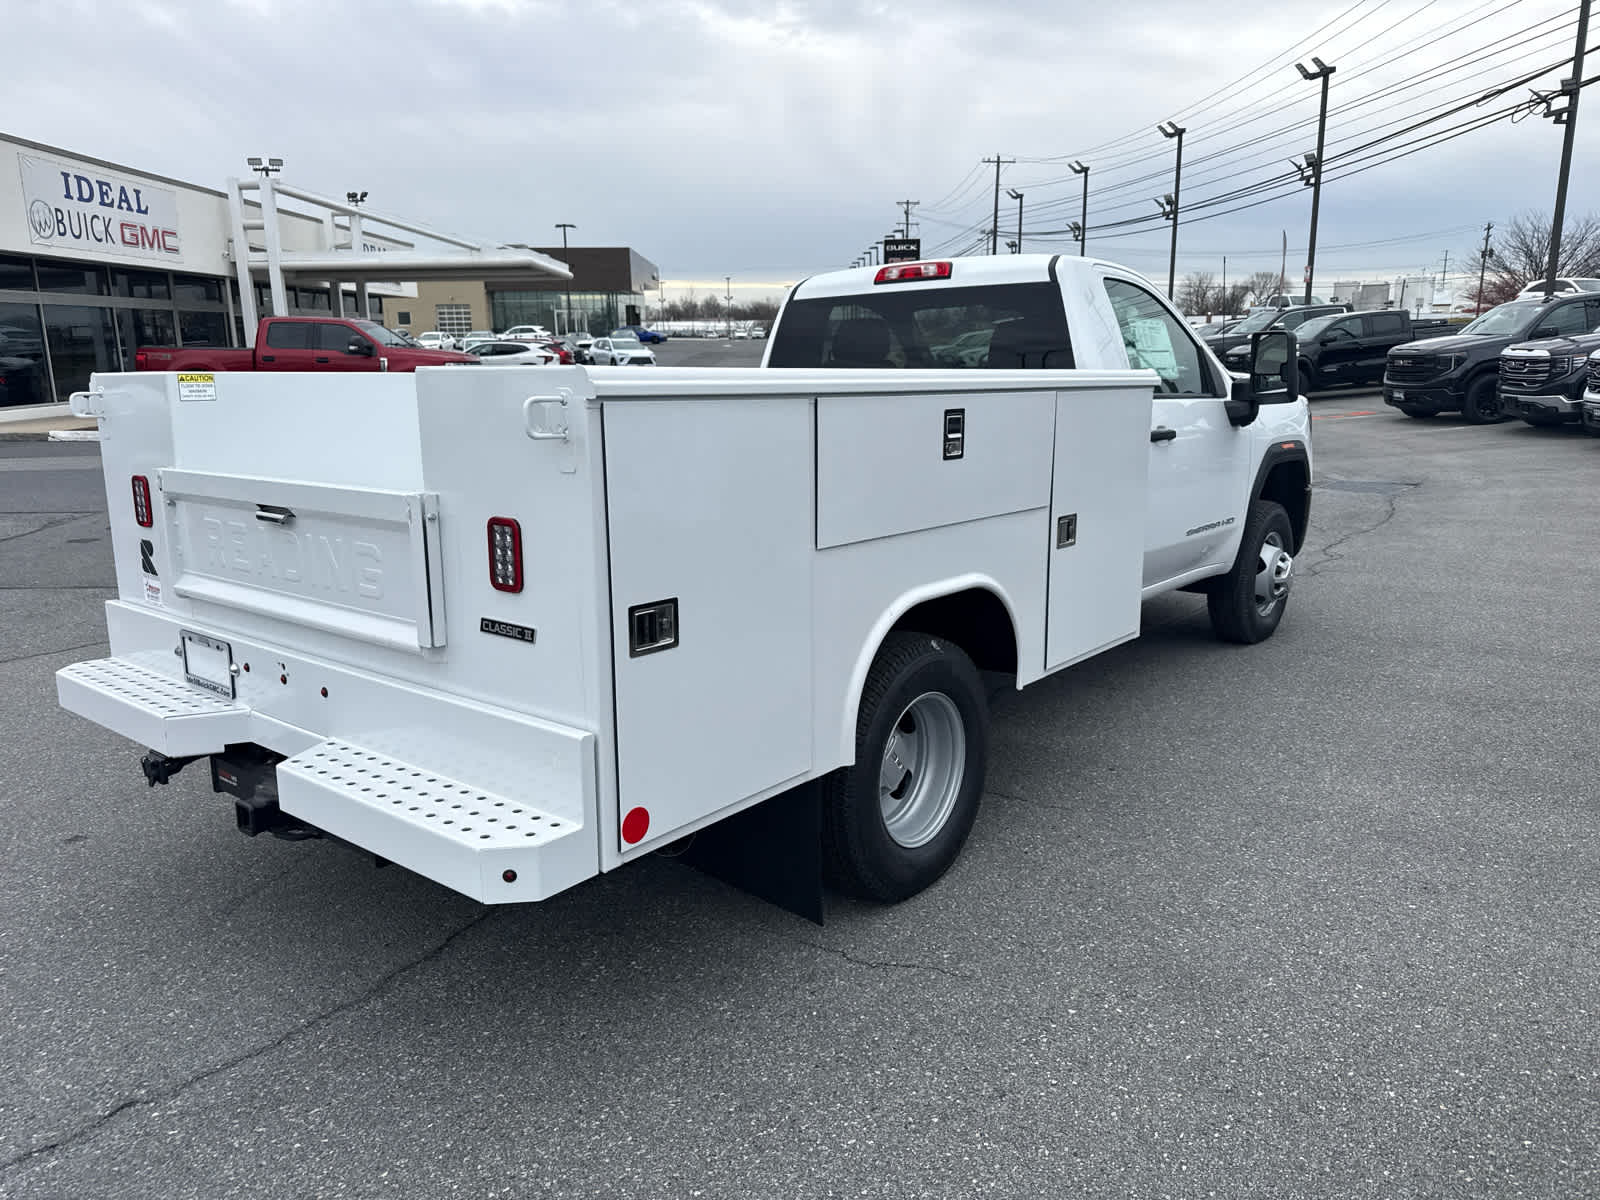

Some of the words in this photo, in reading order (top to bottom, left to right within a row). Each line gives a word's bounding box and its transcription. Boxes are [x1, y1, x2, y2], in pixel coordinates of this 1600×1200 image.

[61, 171, 149, 215] IDEAL
[55, 207, 116, 244] BUICK
[119, 222, 180, 253] GMC
[186, 375, 214, 383] CAUTION
[202, 516, 385, 601] READING
[482, 620, 523, 638] CLASSIC
[523, 629, 533, 641] II
